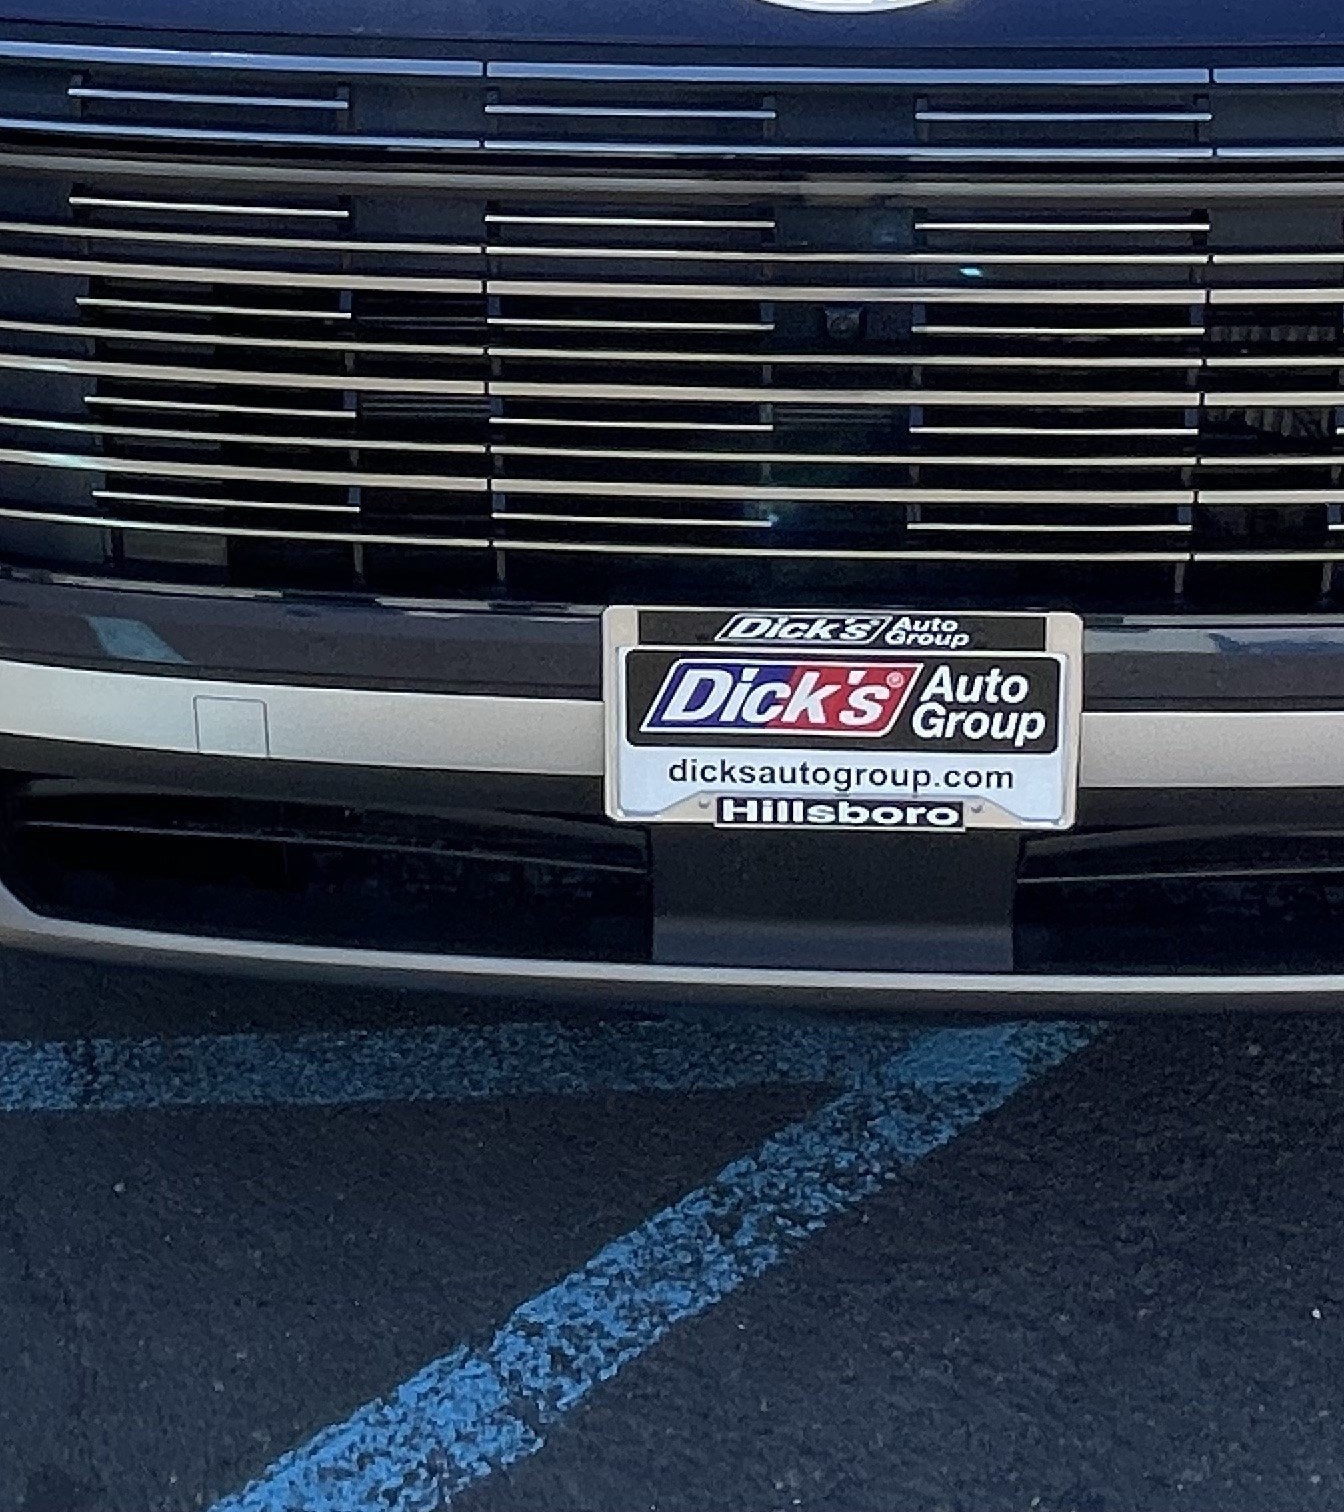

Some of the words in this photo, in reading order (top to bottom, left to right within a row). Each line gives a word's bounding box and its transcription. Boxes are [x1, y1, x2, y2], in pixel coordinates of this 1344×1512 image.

[885, 630, 969, 648] Group
[888, 617, 958, 632] Auto
[662, 668, 892, 726] Dick's
[921, 666, 1028, 703] Auto
[912, 705, 1046, 747] Group
[669, 759, 1014, 793] dicksautogroup.com
[722, 799, 959, 825] Hillsboro
